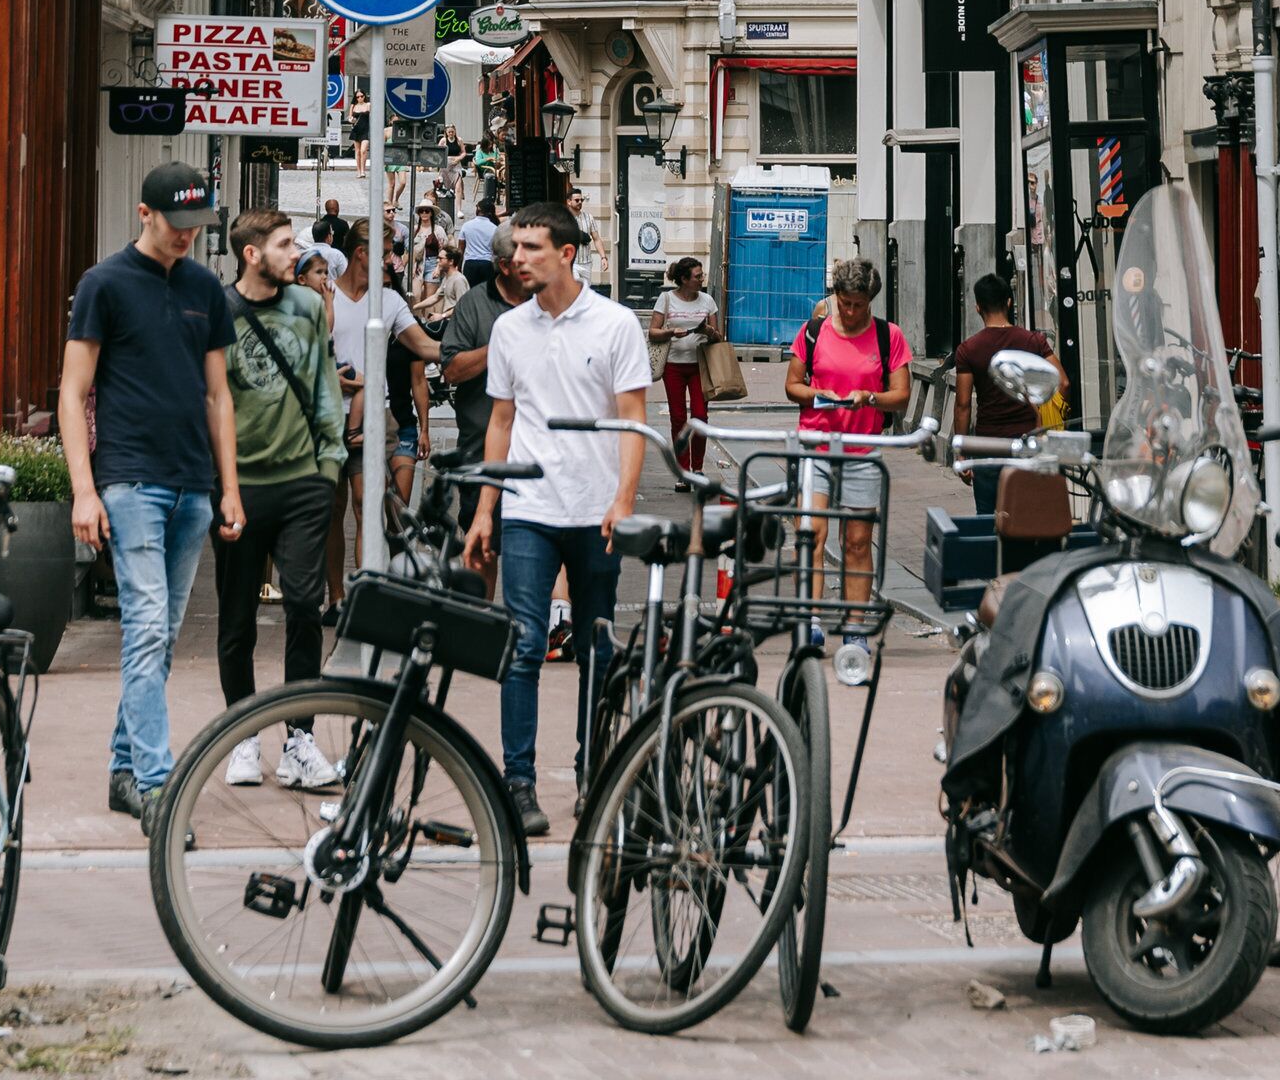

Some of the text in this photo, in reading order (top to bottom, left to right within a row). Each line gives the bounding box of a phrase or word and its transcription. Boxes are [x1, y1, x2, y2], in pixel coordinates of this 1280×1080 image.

[957, 6, 966, 32] NUDE
[173, 24, 267, 45] PIZZA
[392, 28, 409, 36] THE
[386, 43, 426, 52] OCOLATE
[172, 51, 273, 72] PASTA
[184, 105, 308, 126] ALAFEL
